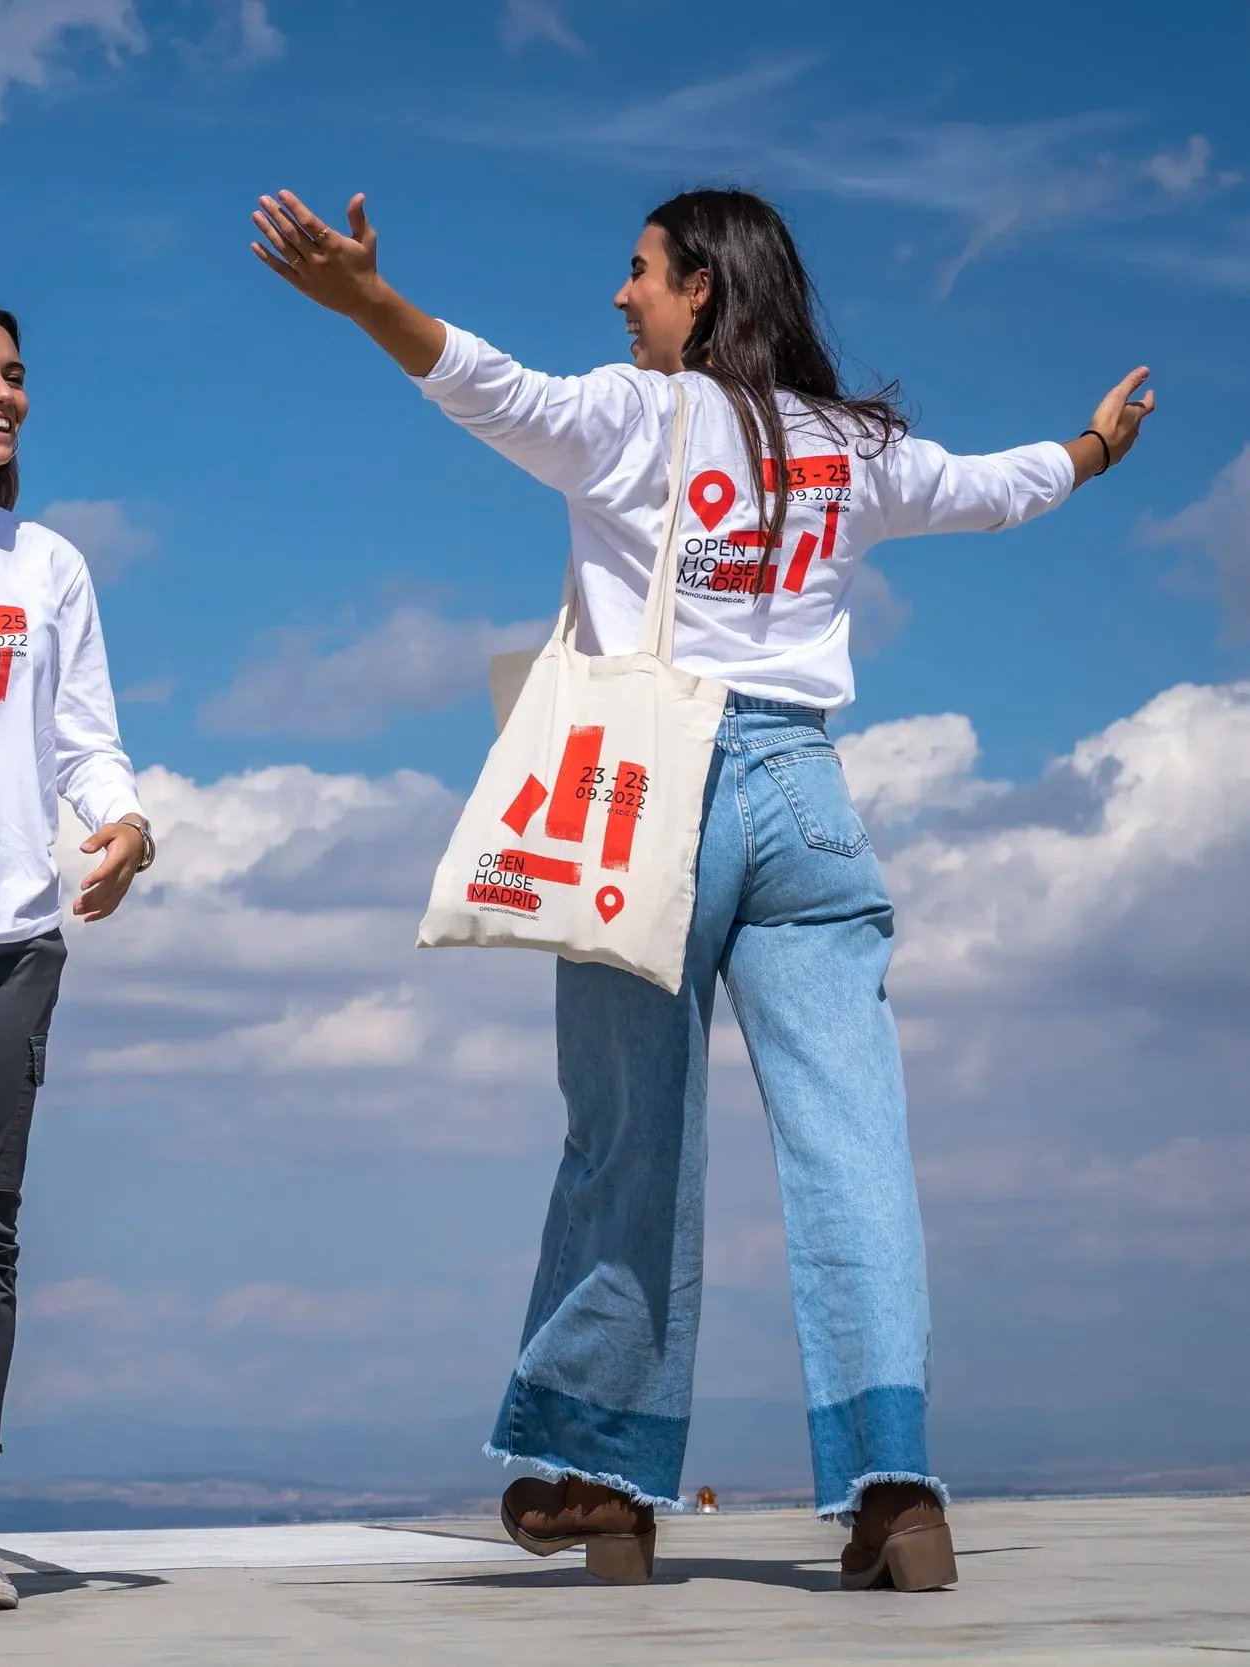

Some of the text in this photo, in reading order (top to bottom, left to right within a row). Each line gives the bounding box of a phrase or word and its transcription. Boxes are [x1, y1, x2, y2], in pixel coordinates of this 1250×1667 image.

[826, 464, 851, 483] 25
[684, 538, 747, 558] OPEN
[682, 556, 758, 576] HOUSE
[0, 613, 27, 630] 25
[580, 766, 606, 784] 23
[624, 771, 650, 793] 25
[575, 786, 646, 810] 09.2022
[478, 853, 525, 873] OPEN
[474, 869, 535, 892] HOUSE
[471, 885, 542, 910] MADRID
